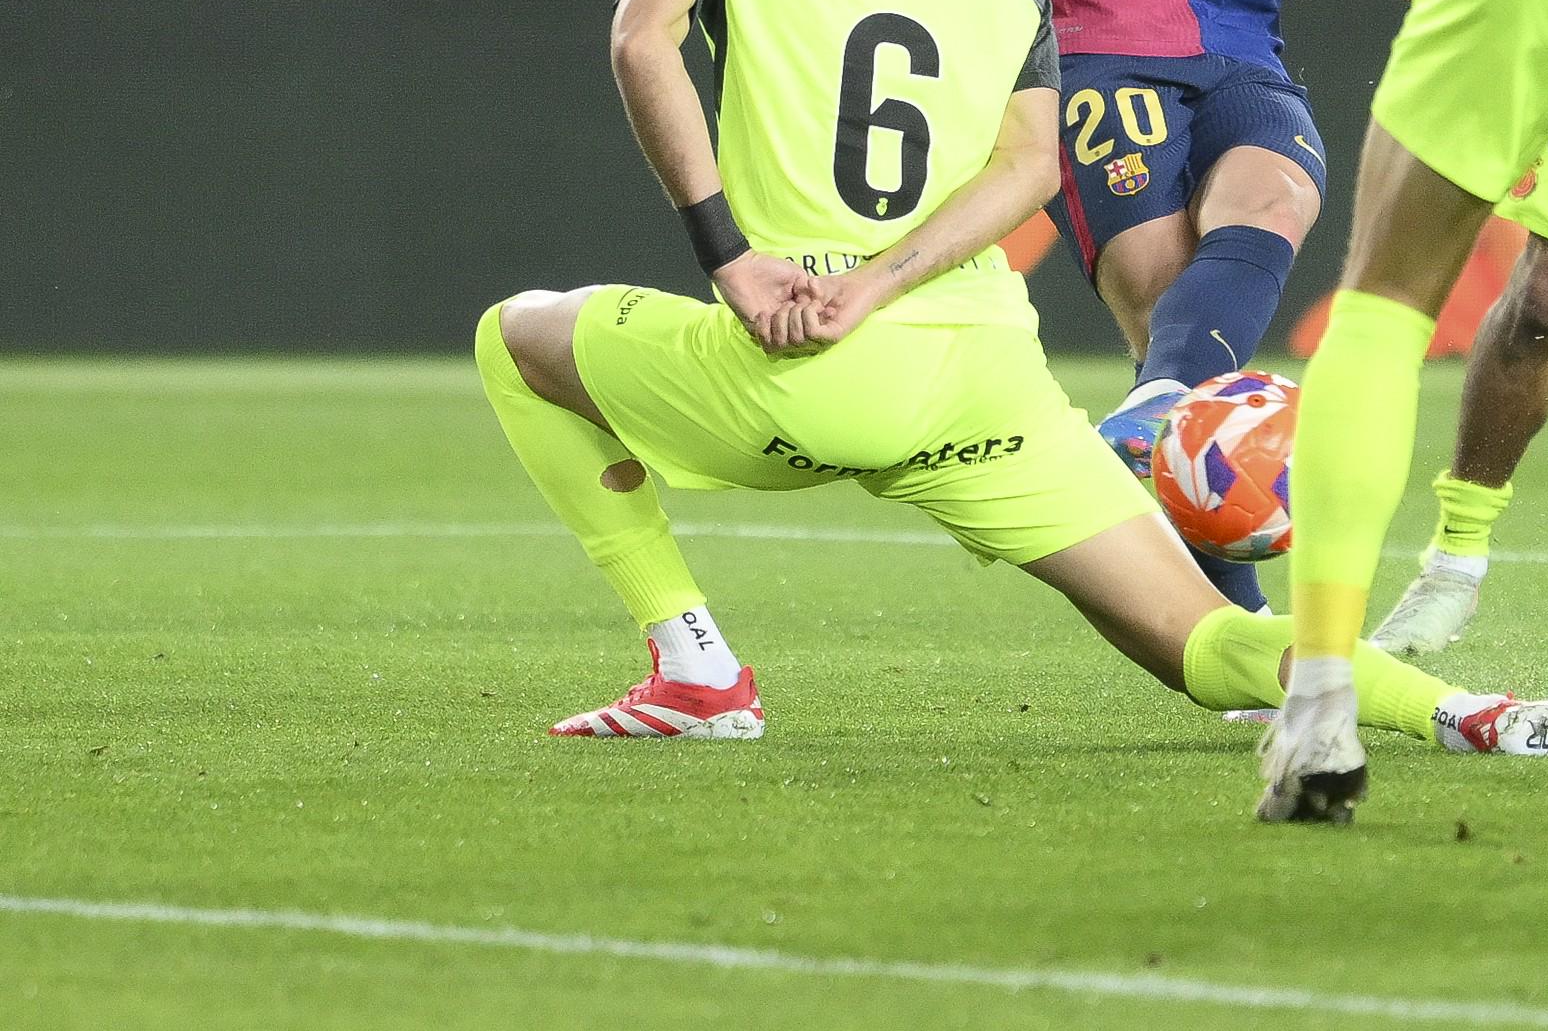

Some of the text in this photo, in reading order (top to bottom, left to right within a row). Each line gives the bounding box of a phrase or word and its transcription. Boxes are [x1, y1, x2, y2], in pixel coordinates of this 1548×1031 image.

[832, 12, 940, 222] 6
[1065, 87, 1168, 166] 20
[761, 434, 1026, 478] Formntera
[681, 611, 715, 652] OAL
